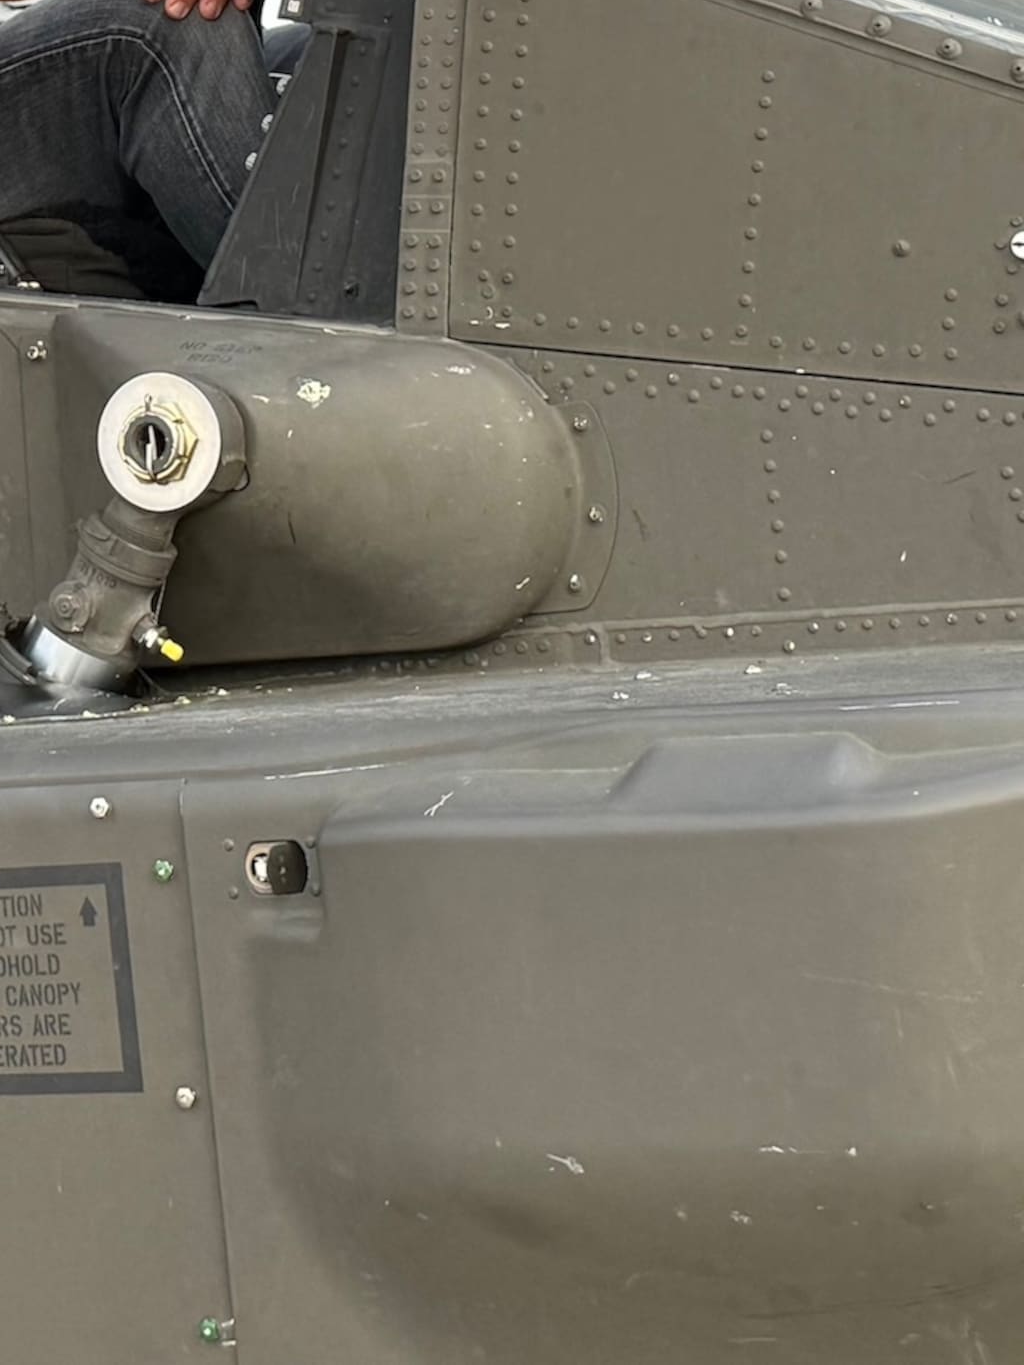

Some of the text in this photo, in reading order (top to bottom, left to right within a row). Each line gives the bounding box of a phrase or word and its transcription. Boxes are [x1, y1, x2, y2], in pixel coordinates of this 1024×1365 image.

[26, 923, 67, 946] USE
[6, 982, 81, 1007] CANOPY
[33, 1013, 71, 1036] ARE
